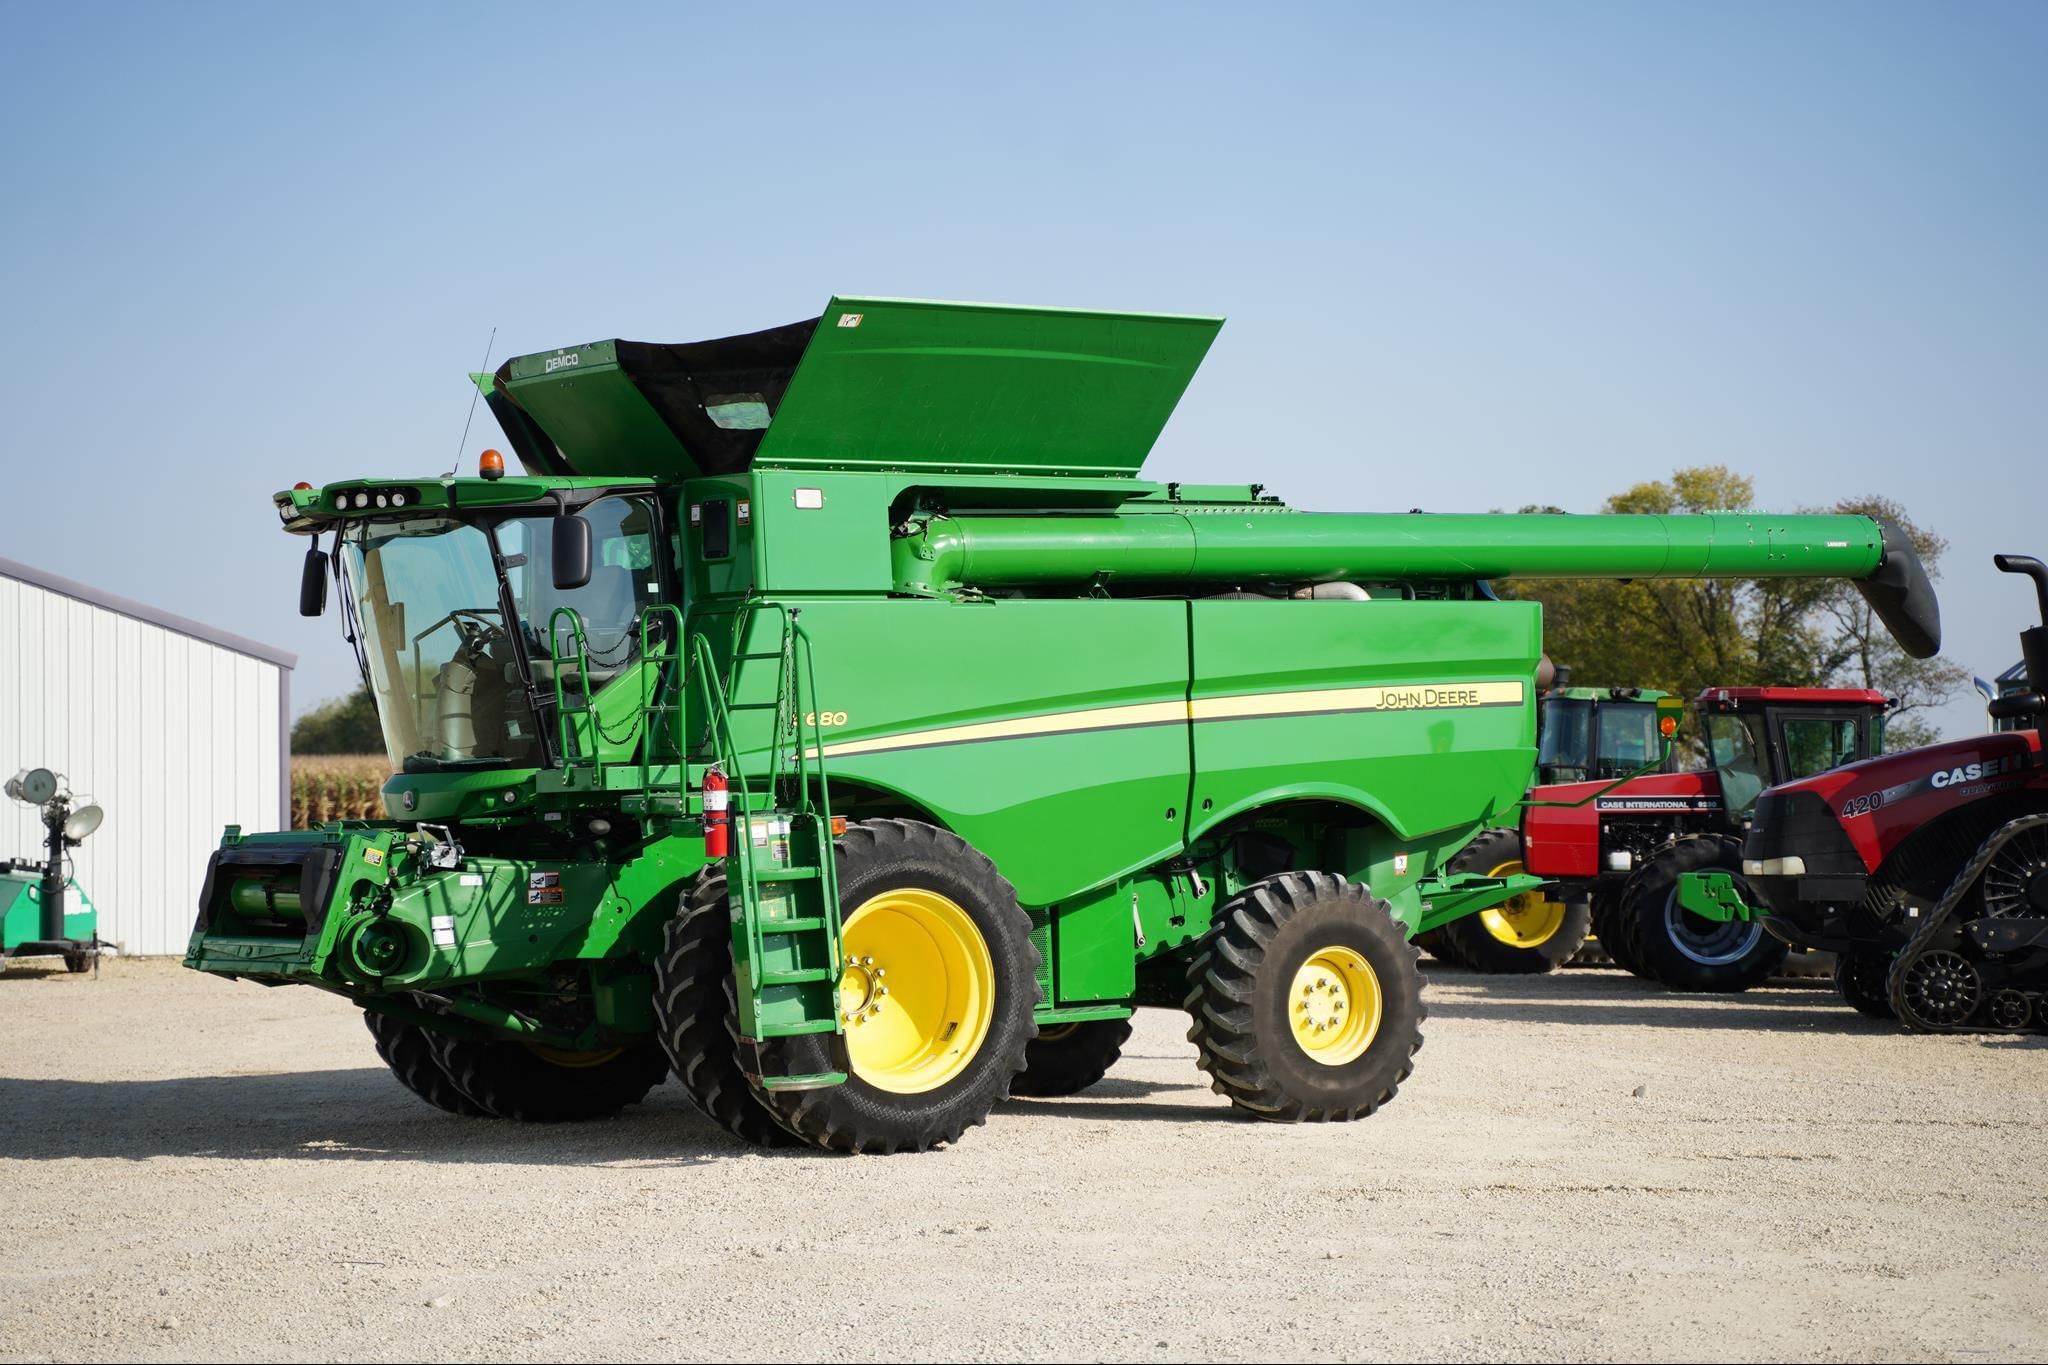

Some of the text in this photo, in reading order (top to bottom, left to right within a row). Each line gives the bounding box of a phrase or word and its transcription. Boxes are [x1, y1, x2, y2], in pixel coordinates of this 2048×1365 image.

[545, 354, 579, 374] DEMCO
[1376, 689, 1478, 707] JOHN DEERE
[1931, 759, 1999, 788] CASE
[1601, 801, 1624, 809] CASE
[1625, 801, 1689, 809] INTERNATIONAL
[1842, 791, 1885, 818] 420
